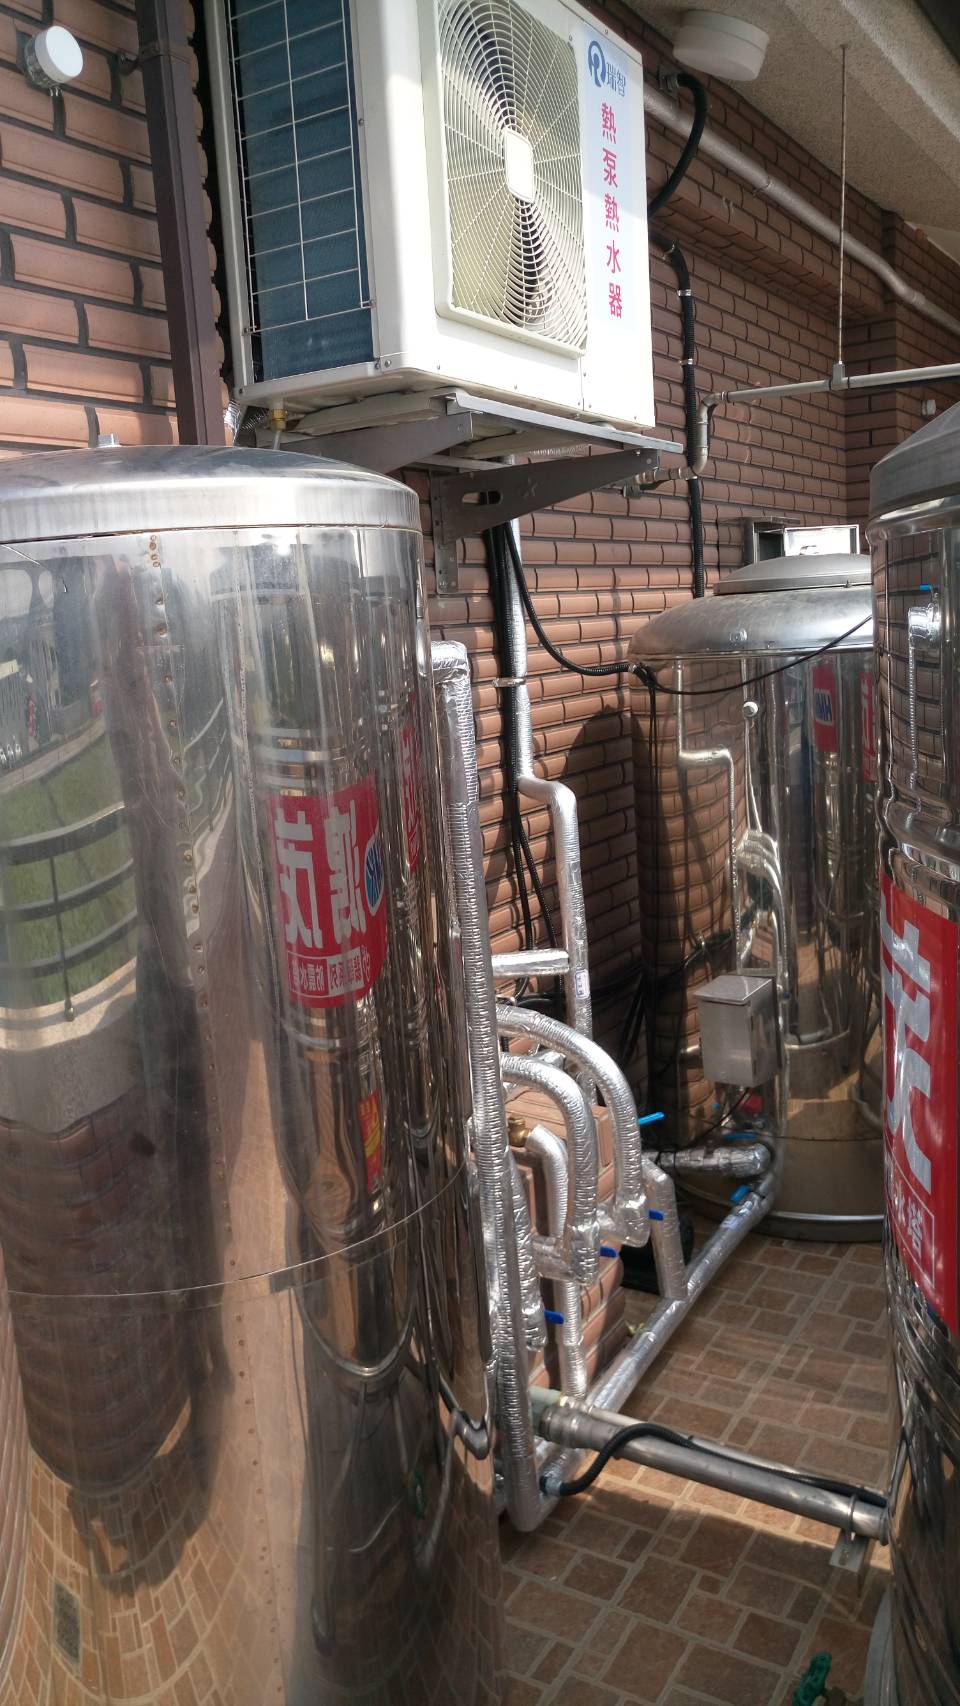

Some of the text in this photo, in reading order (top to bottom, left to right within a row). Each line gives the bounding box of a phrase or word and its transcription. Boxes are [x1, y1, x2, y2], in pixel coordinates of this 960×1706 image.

[601, 102, 623, 319] 熱泵熱水器
